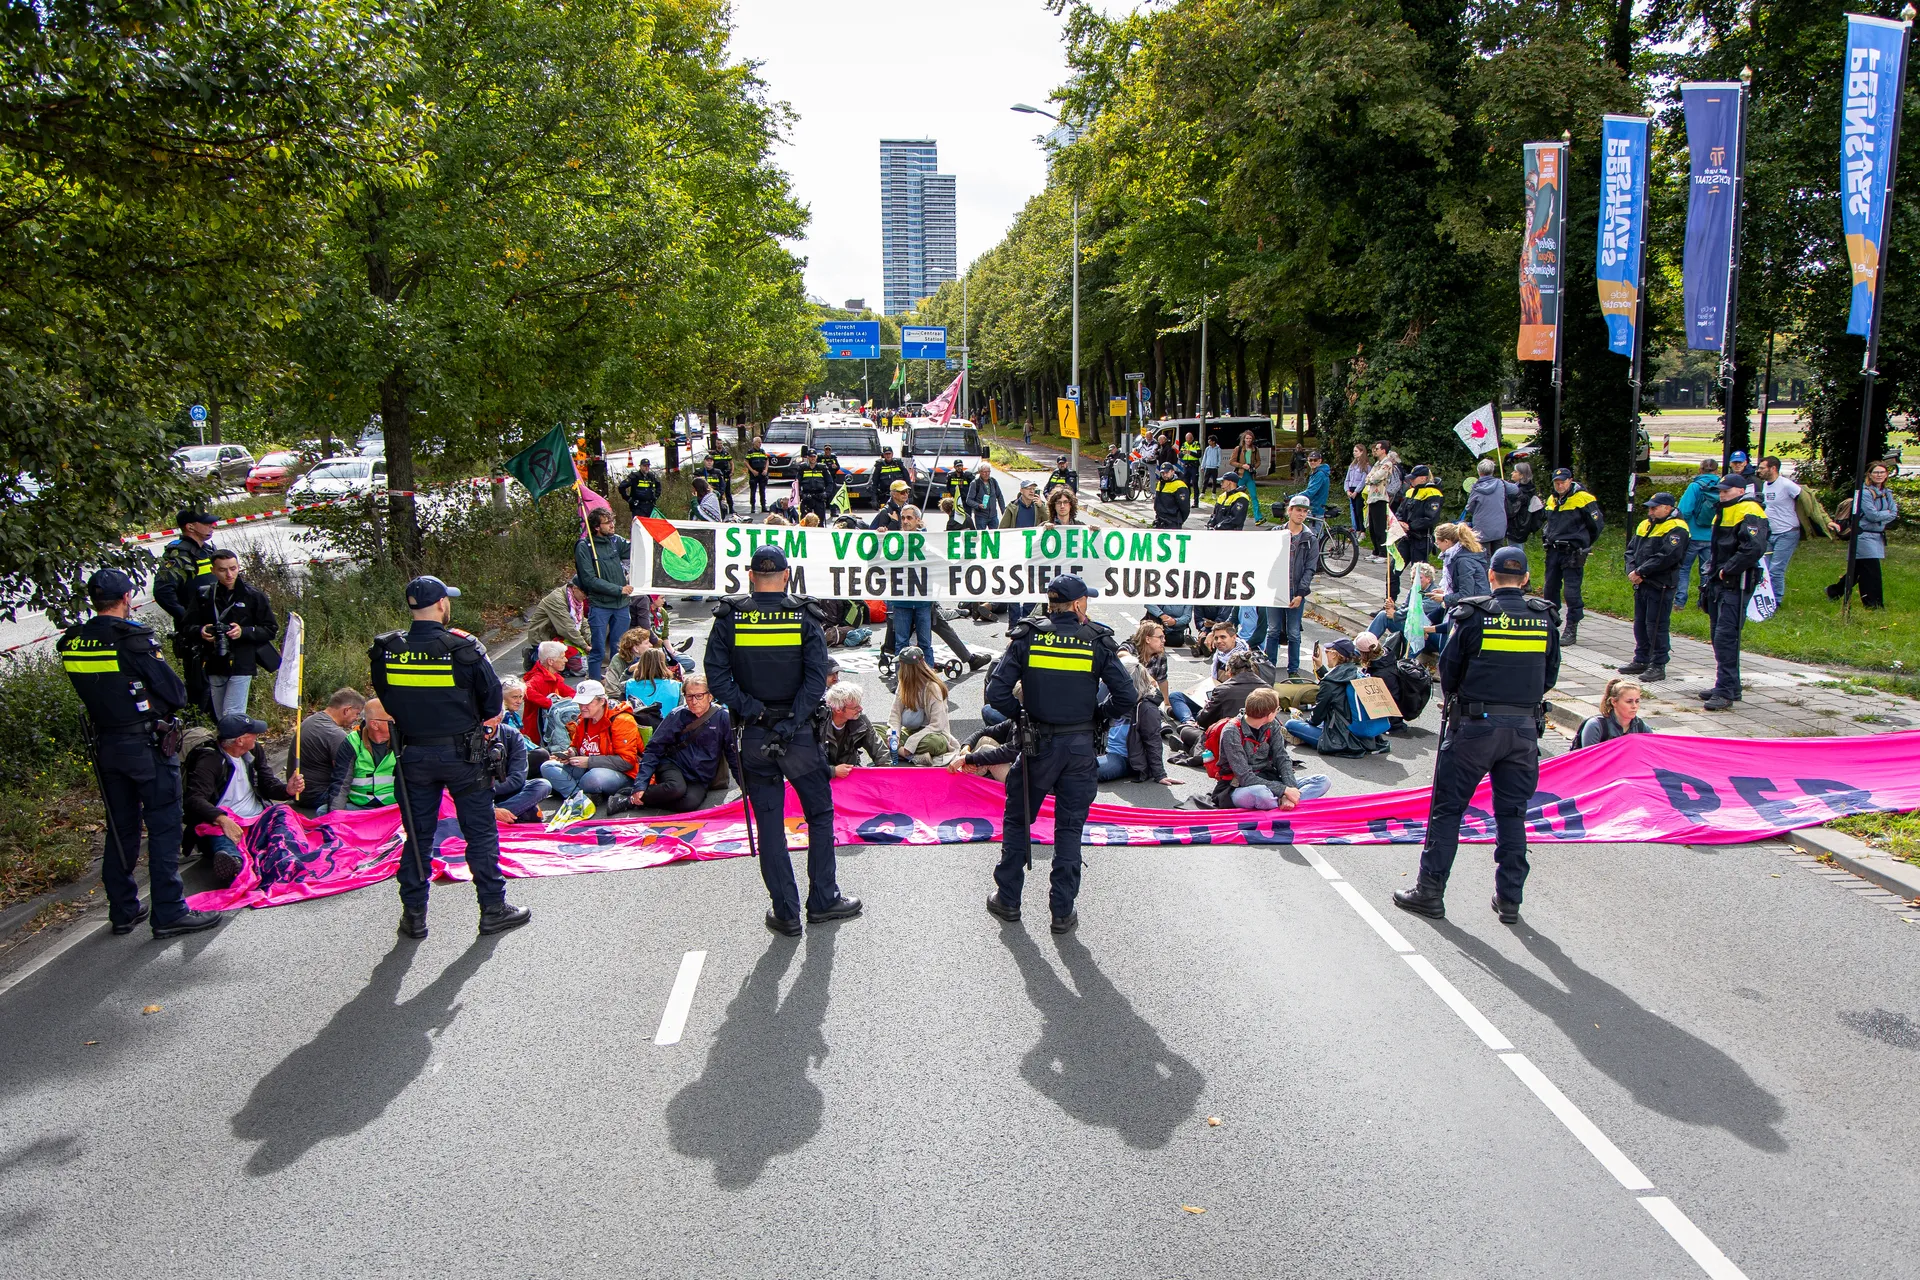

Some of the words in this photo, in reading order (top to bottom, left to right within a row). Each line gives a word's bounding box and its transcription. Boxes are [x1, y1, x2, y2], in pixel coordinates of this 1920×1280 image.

[832, 531, 926, 562] VOOR
[947, 530, 1001, 560] EEN
[1022, 529, 1191, 563] TOEKOMST
[725, 564, 807, 595] SM
[829, 566, 928, 597] TEGEN
[1104, 566, 1255, 600] SUBSIDIES
